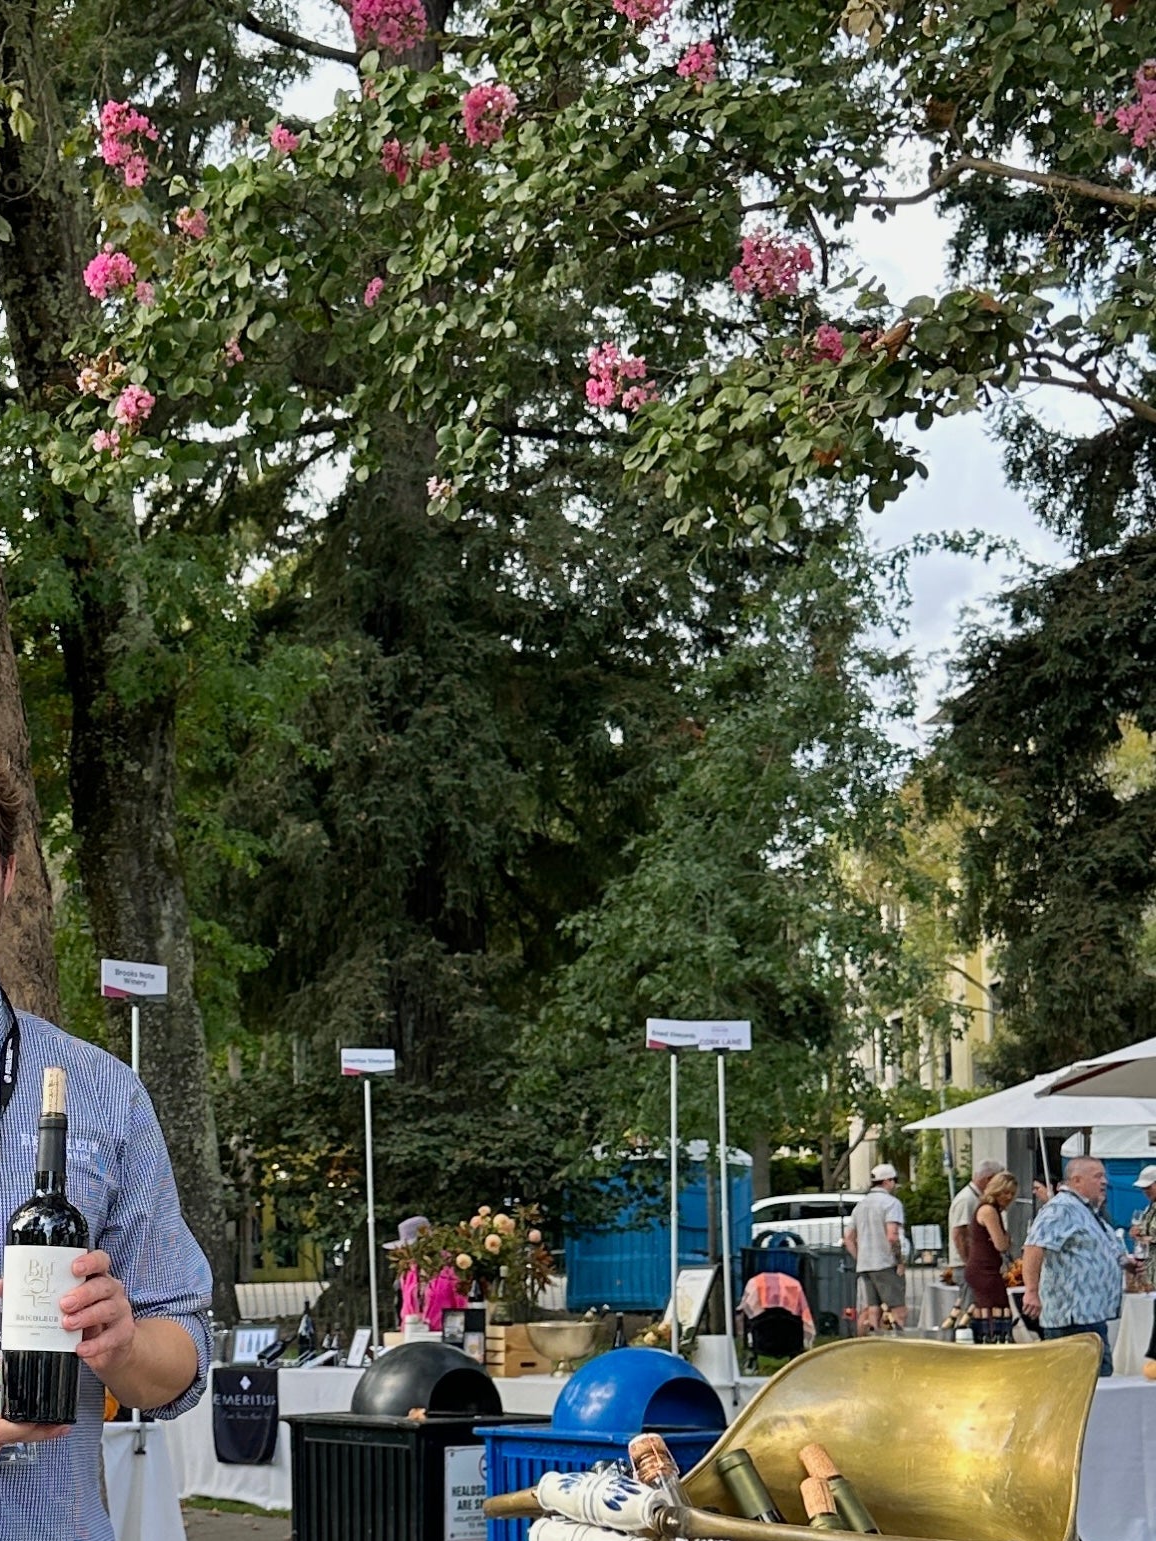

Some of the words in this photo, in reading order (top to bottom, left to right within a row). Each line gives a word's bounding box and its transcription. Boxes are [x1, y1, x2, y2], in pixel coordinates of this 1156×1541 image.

[115, 968, 138, 978] Brooks
[124, 978, 147, 988] Winery
[698, 1038, 720, 1046] CORK
[722, 1038, 742, 1046] LANE
[451, 1485, 486, 1497] HEALDSB
[457, 1500, 472, 1510] ARE
